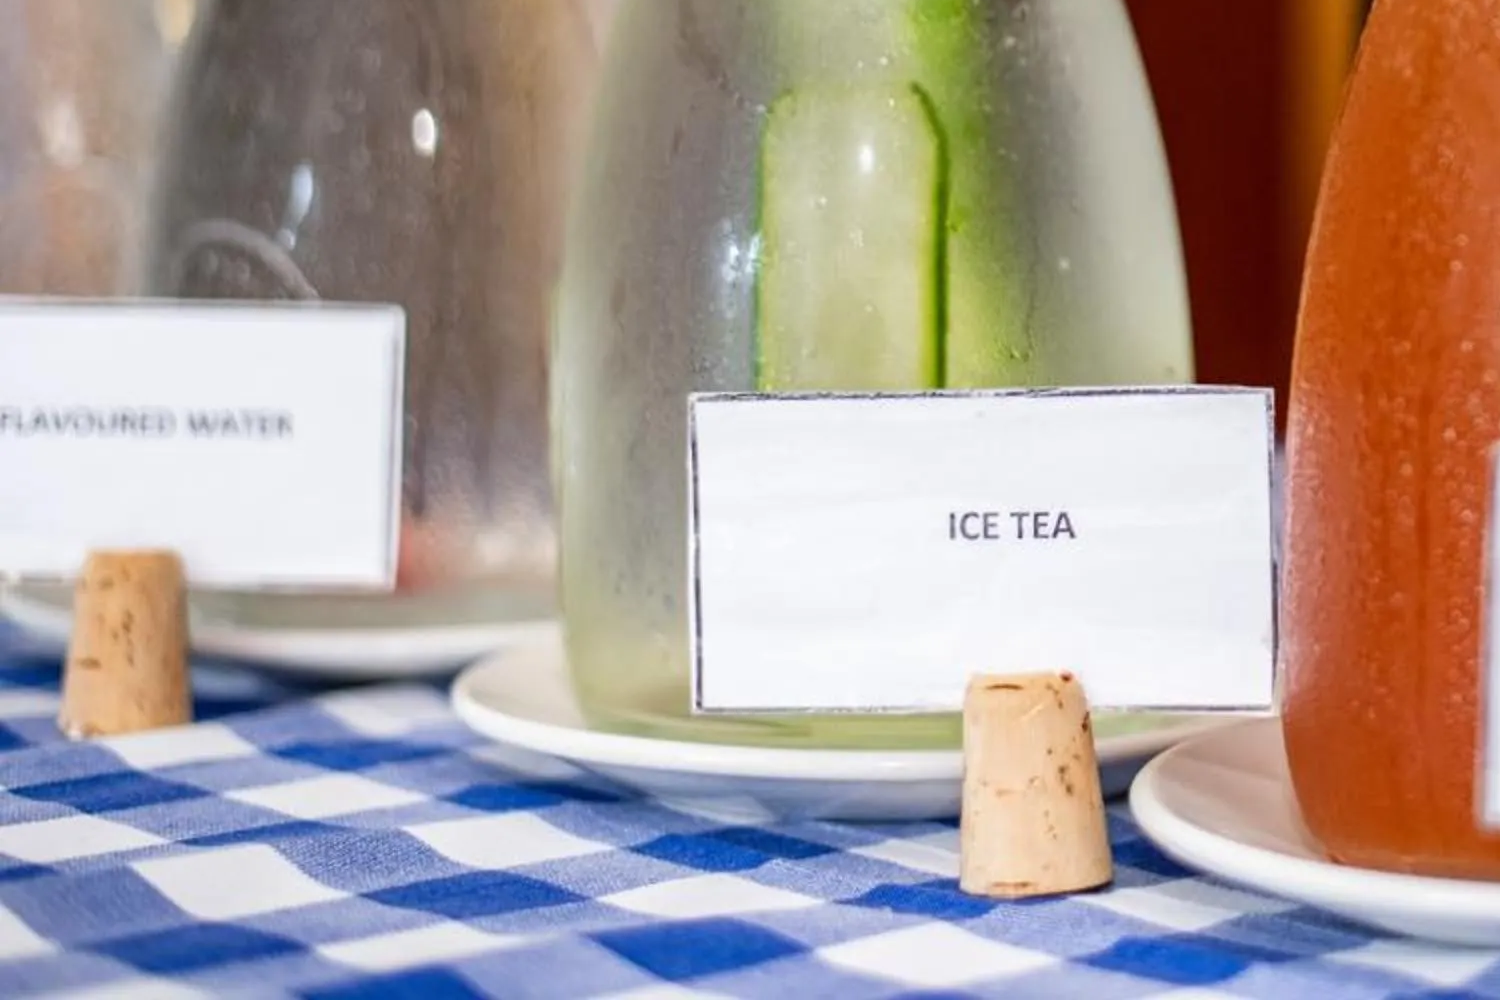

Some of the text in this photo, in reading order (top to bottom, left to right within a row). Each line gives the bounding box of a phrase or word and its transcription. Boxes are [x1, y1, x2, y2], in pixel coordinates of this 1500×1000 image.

[0, 406, 293, 437] FLAVOURED WATER
[949, 511, 1076, 540] ICE TEA
